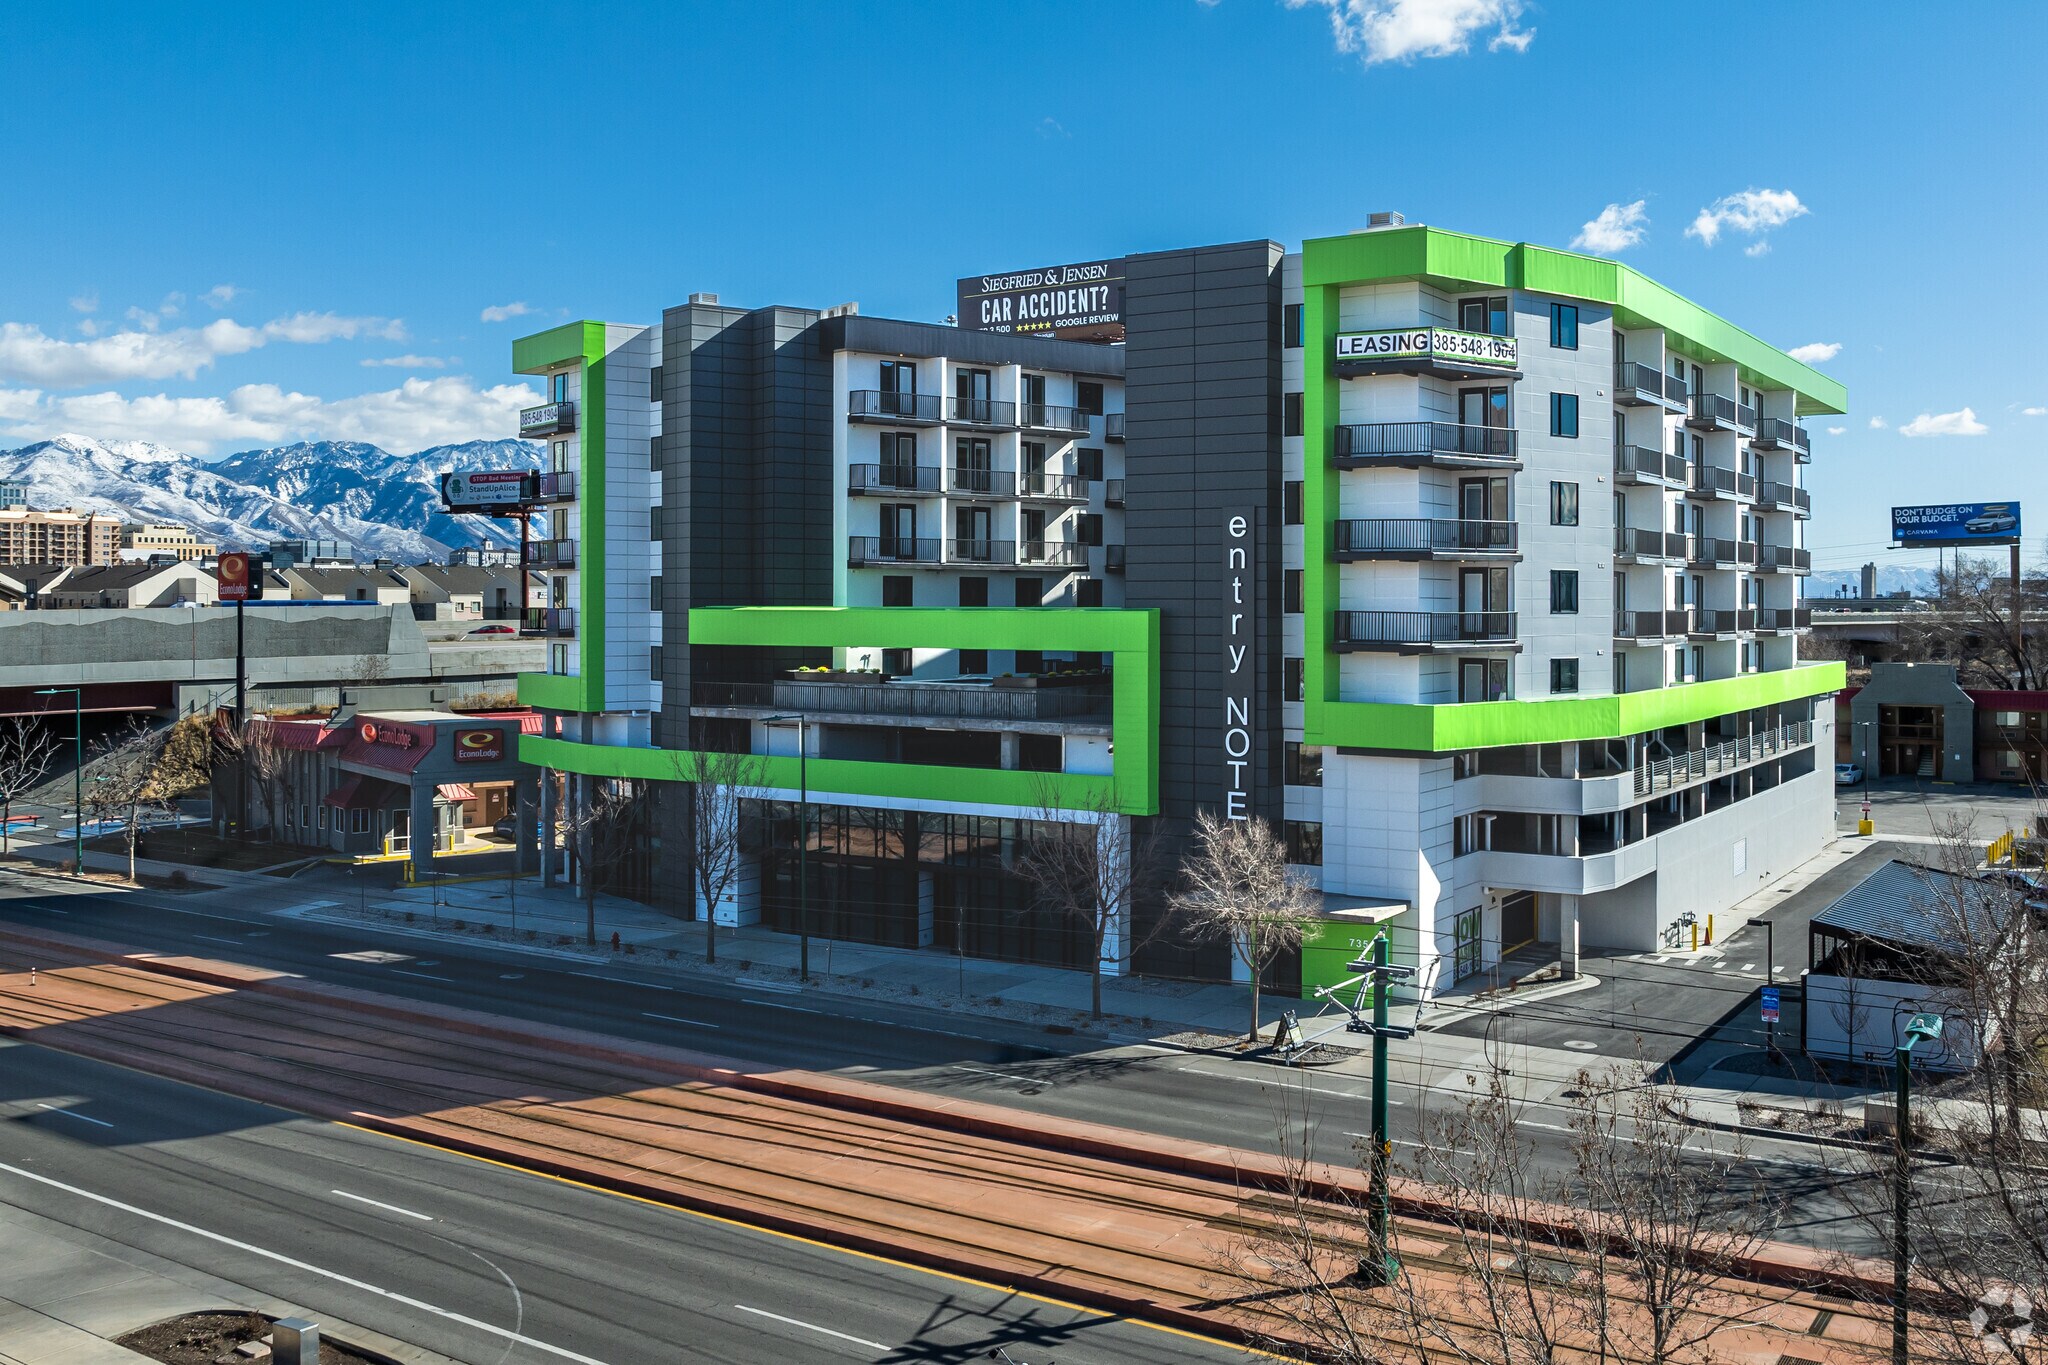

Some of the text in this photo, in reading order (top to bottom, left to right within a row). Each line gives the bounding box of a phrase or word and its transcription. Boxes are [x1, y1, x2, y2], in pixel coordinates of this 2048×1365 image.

[981, 264, 1108, 293] SIEGFRIED & JENSEN
[981, 285, 1109, 324] CAR ACCIDENT?
[1055, 317, 1087, 328] GOOGLE
[1089, 313, 1119, 324] REVIEW
[1338, 333, 1428, 355] LEASING
[1895, 508, 1924, 517] DON'T
[1925, 507, 1956, 516] BUDGE
[1895, 514, 1959, 524] YOUR BUDGET.
[1225, 515, 1250, 820] entry NOTE
